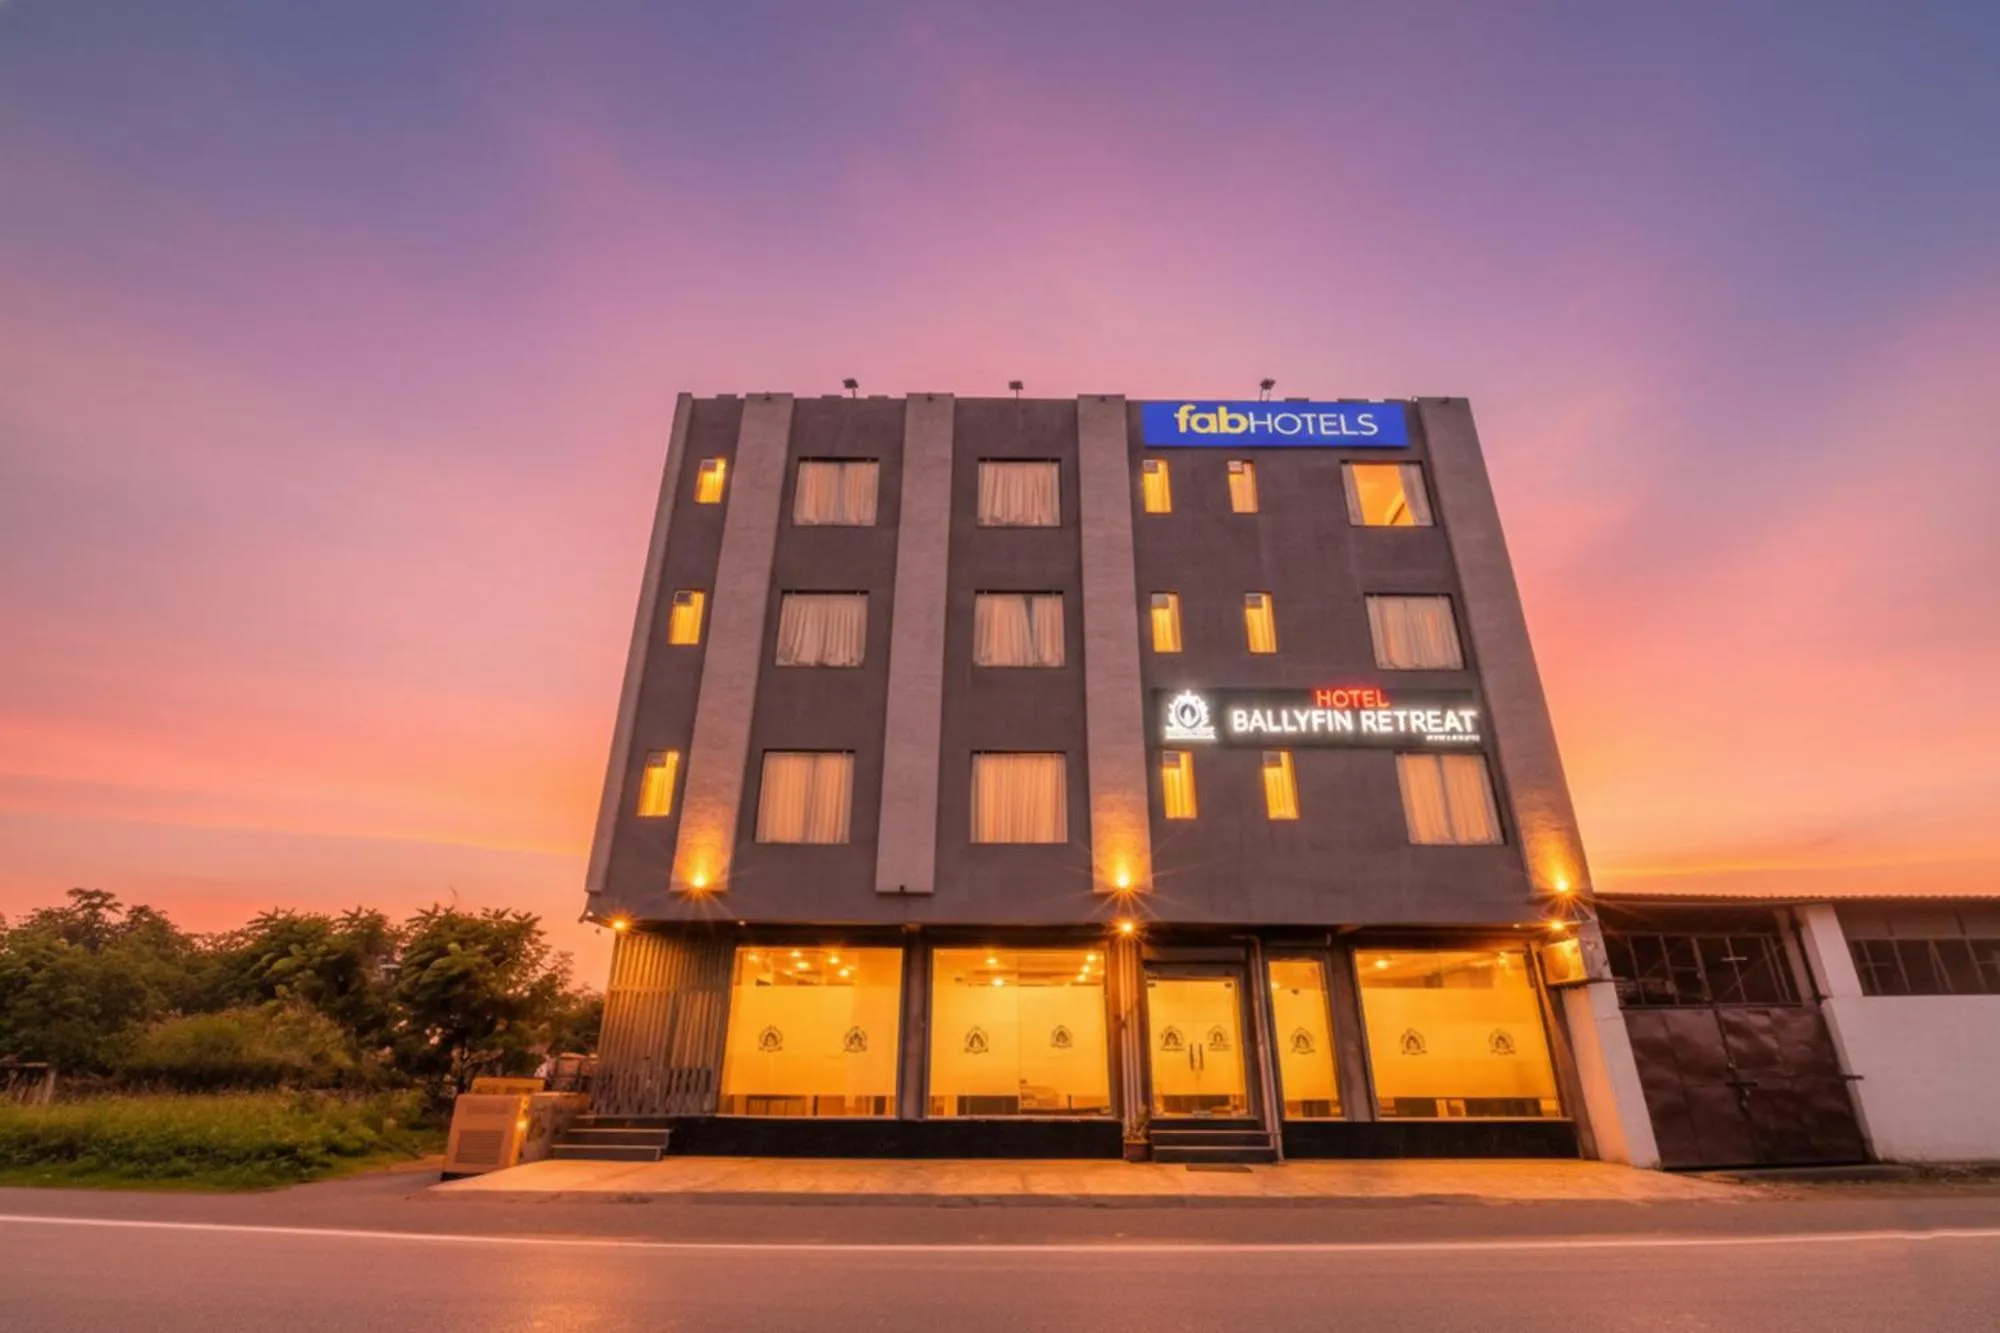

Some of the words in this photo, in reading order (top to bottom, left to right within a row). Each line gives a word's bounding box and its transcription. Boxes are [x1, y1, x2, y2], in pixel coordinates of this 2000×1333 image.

[1315, 689, 1390, 708] HOTEL
[1231, 709, 1351, 733] BALLYFIN
[1360, 710, 1477, 733] RETREAT
